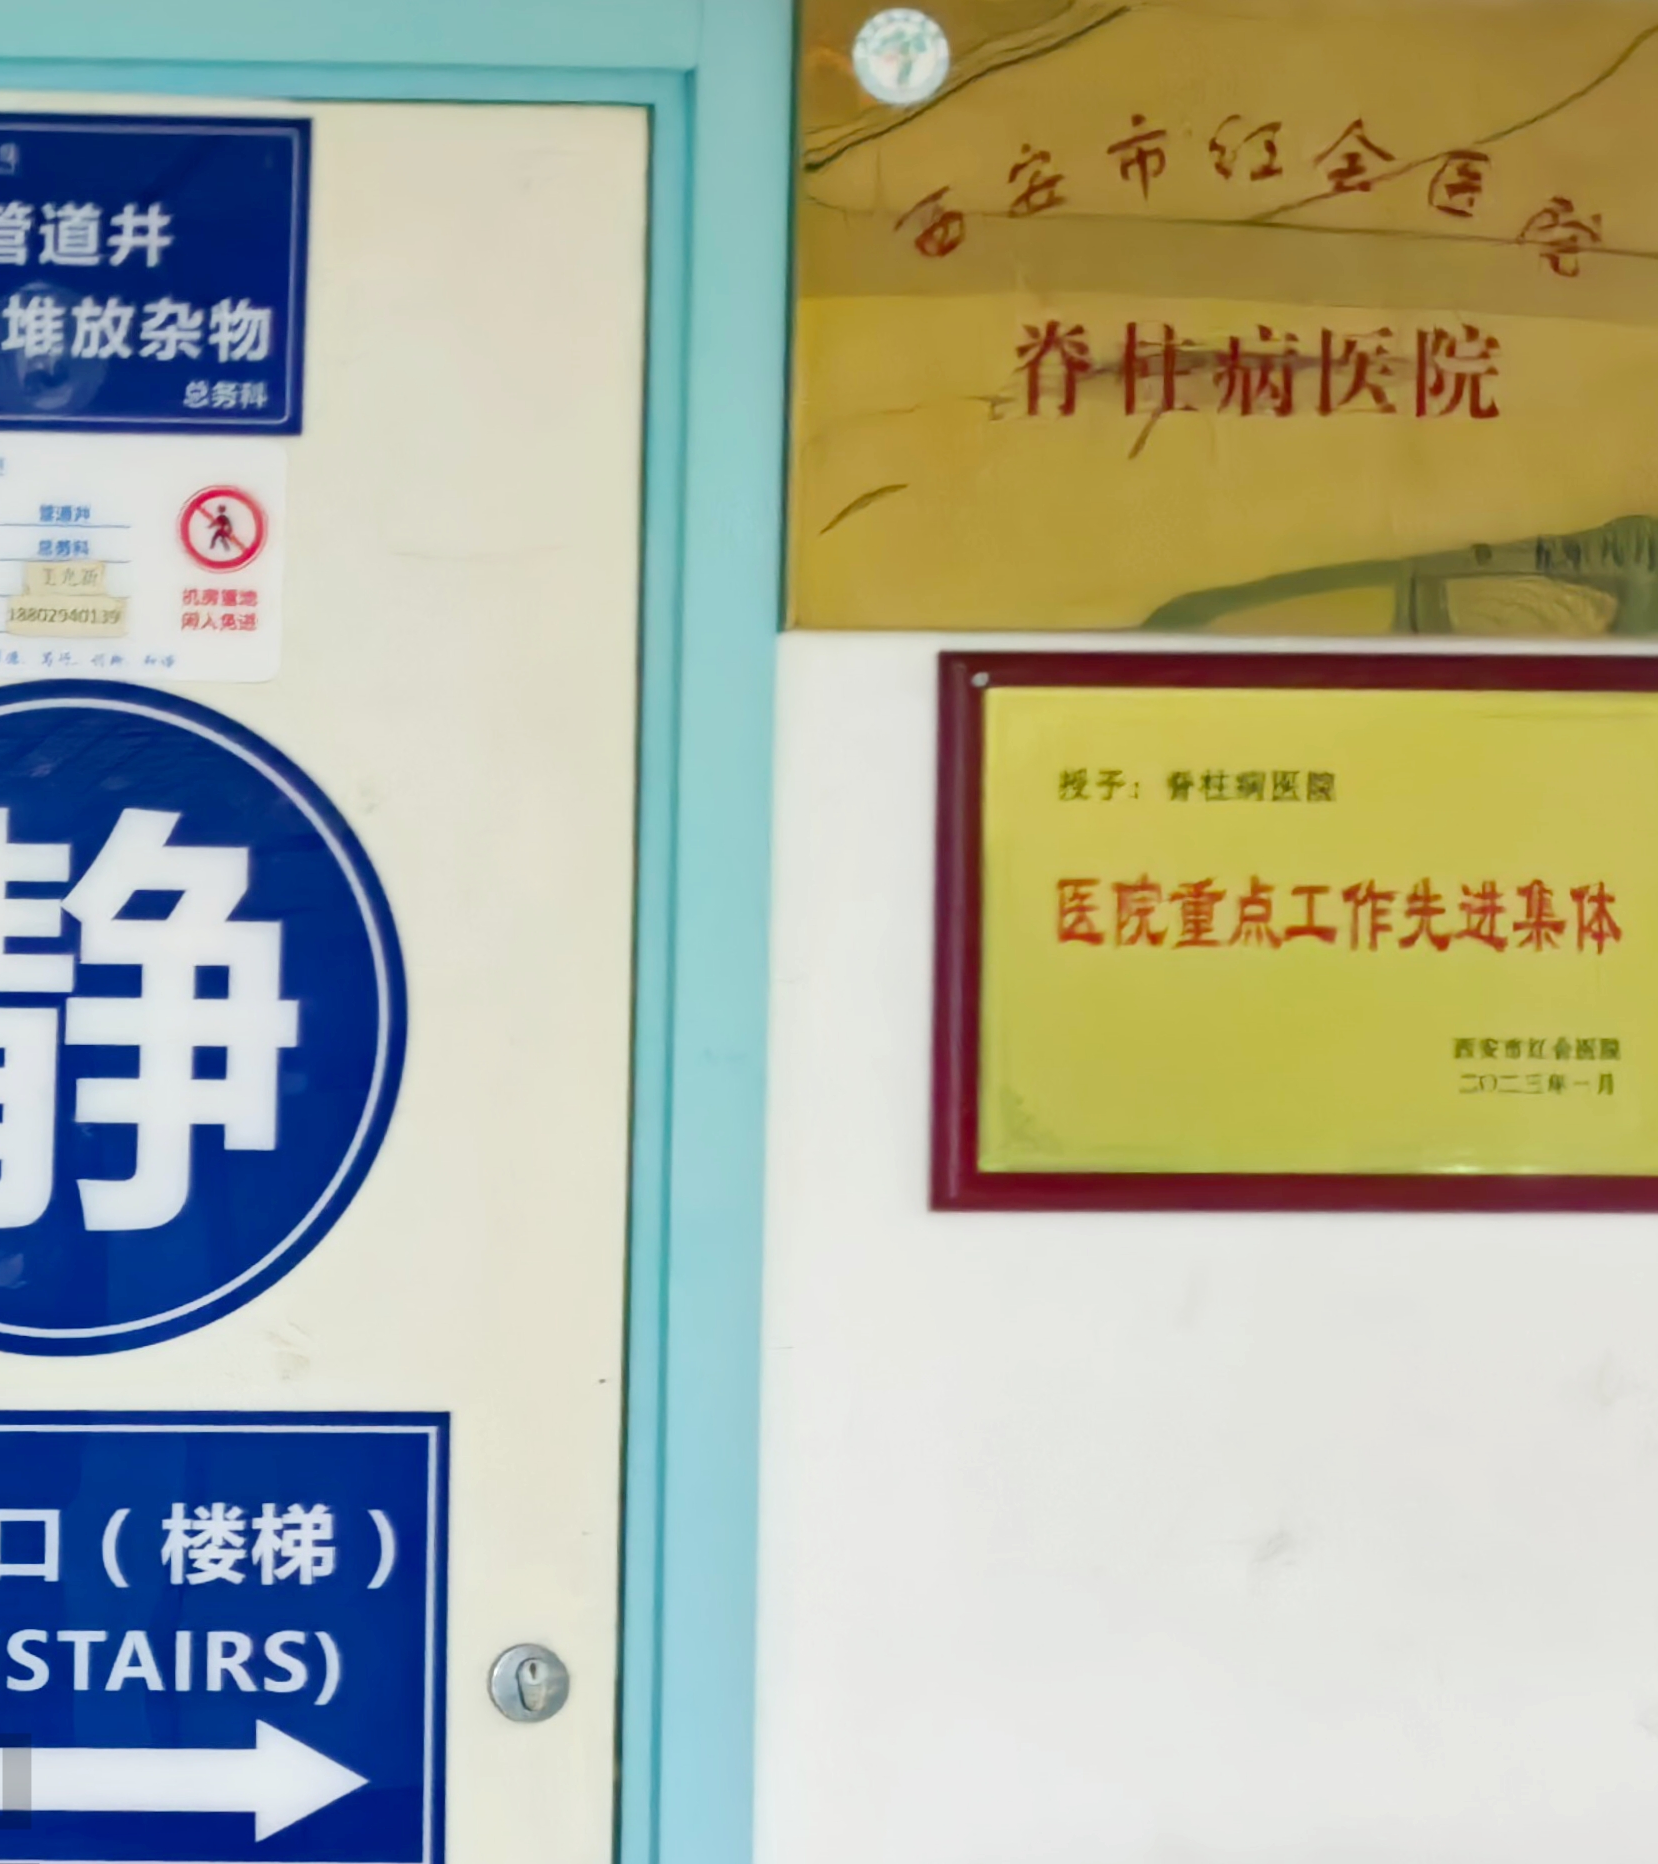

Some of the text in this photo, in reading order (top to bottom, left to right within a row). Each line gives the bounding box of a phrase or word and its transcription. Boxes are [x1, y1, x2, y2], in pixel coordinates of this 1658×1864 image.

[183, 380, 268, 410] 总务科
[1014, 321, 1501, 420] 脊柱病医院
[1055, 873, 1624, 956] 医院重点工作先进集体
